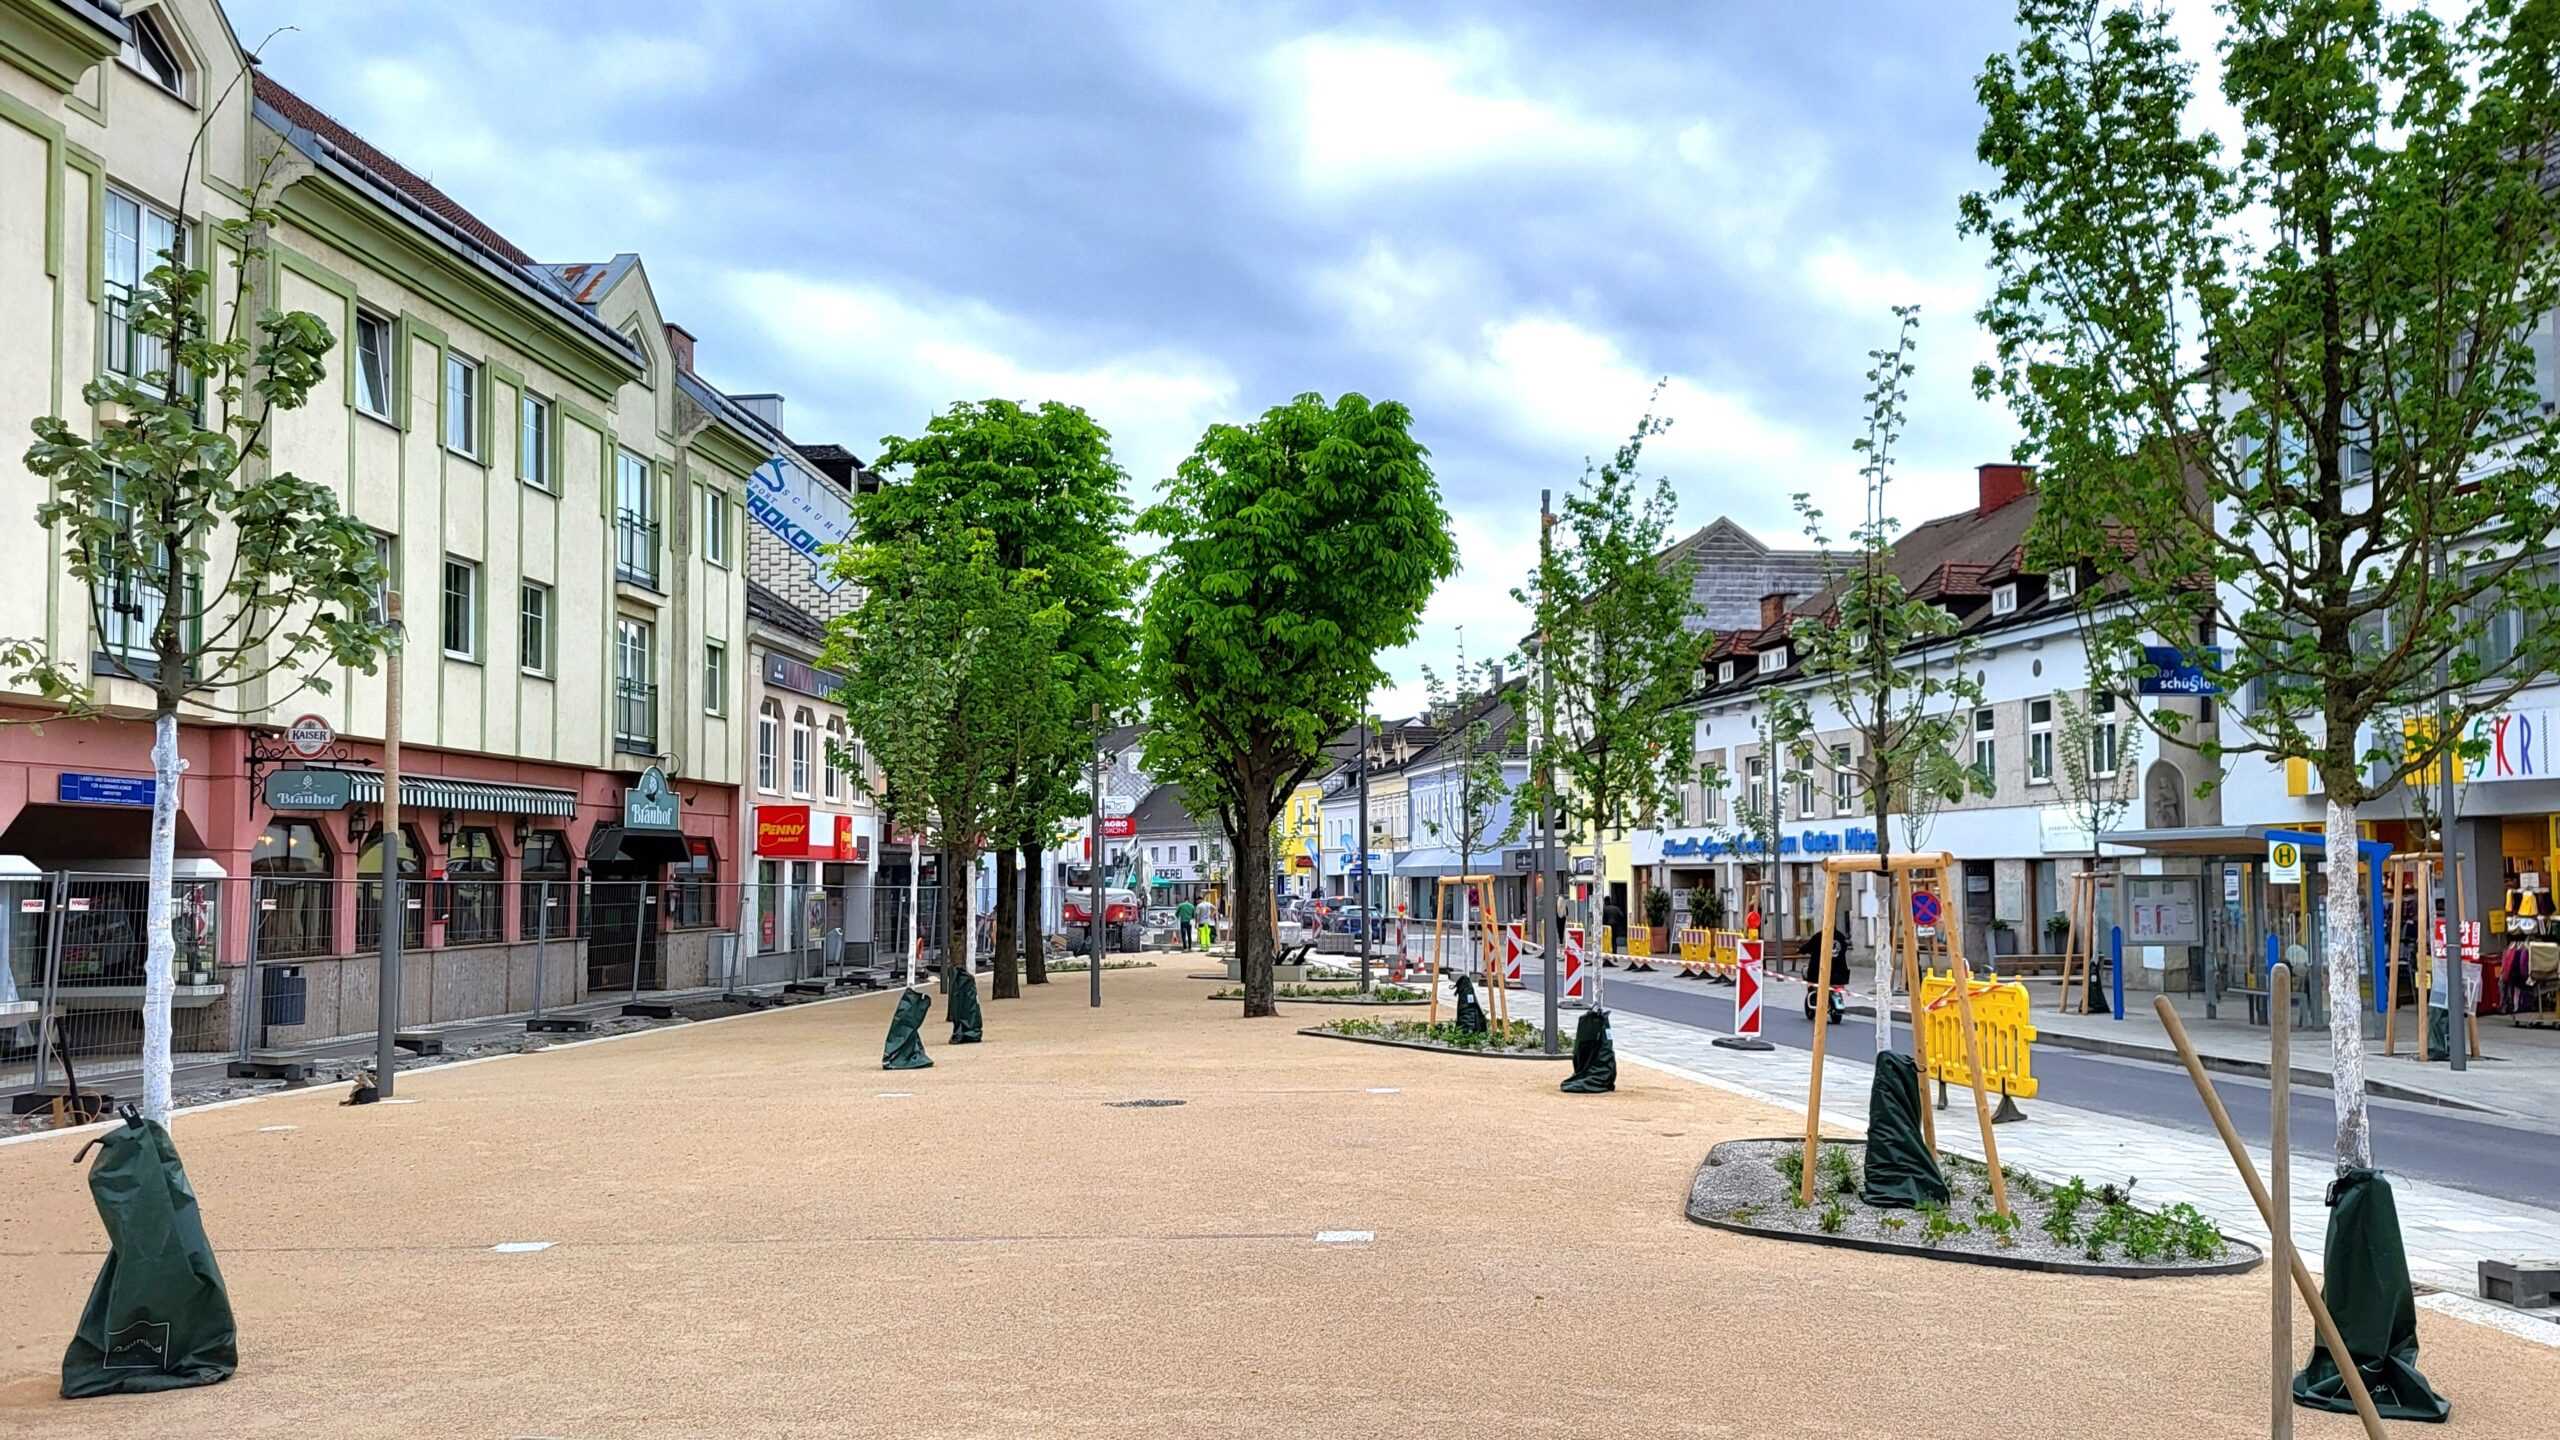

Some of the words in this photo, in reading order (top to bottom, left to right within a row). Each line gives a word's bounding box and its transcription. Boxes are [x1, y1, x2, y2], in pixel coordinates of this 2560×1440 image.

[782, 488, 845, 538] SCHUHE
[292, 730, 328, 740] KAISER
[277, 793, 339, 804] Brauhof
[631, 804, 673, 825] Brauhof
[759, 822, 806, 836] PENNY
[1802, 829, 1842, 853] Guten
[1845, 826, 1878, 853] Hirte
